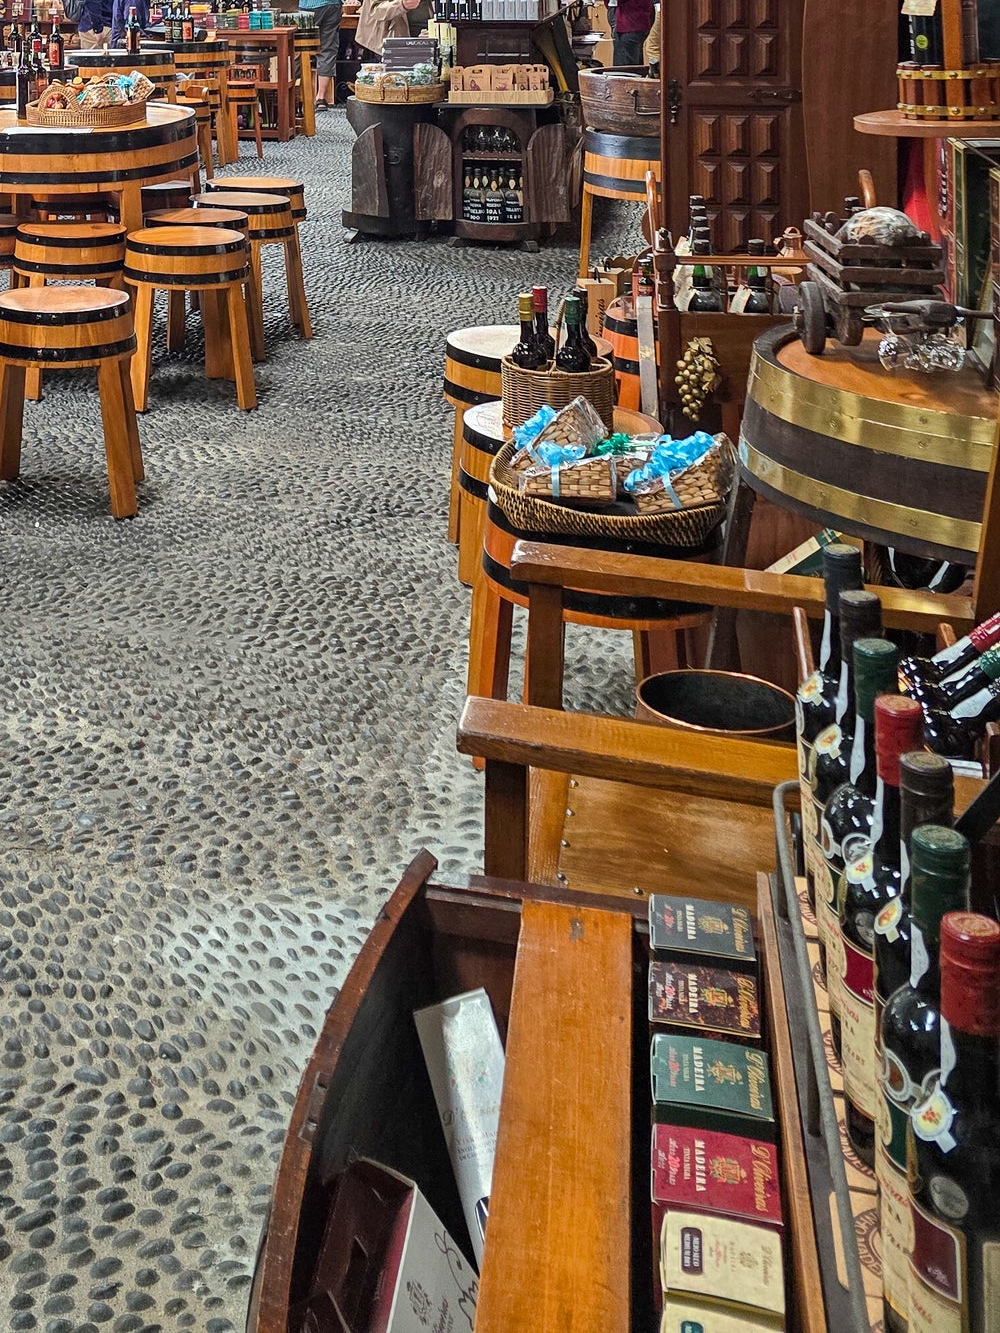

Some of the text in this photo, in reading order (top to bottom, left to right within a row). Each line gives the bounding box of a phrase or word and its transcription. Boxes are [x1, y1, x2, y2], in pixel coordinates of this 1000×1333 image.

[685, 903, 697, 940] MADEIRA
[688, 972, 699, 1014] MADEIRA
[692, 1046, 705, 1092] MADEIRA
[745, 1050, 766, 1110] D'Oliveiras
[694, 1139, 707, 1192] MADEIRA
[750, 1144, 772, 1213] D'Oliveiras
